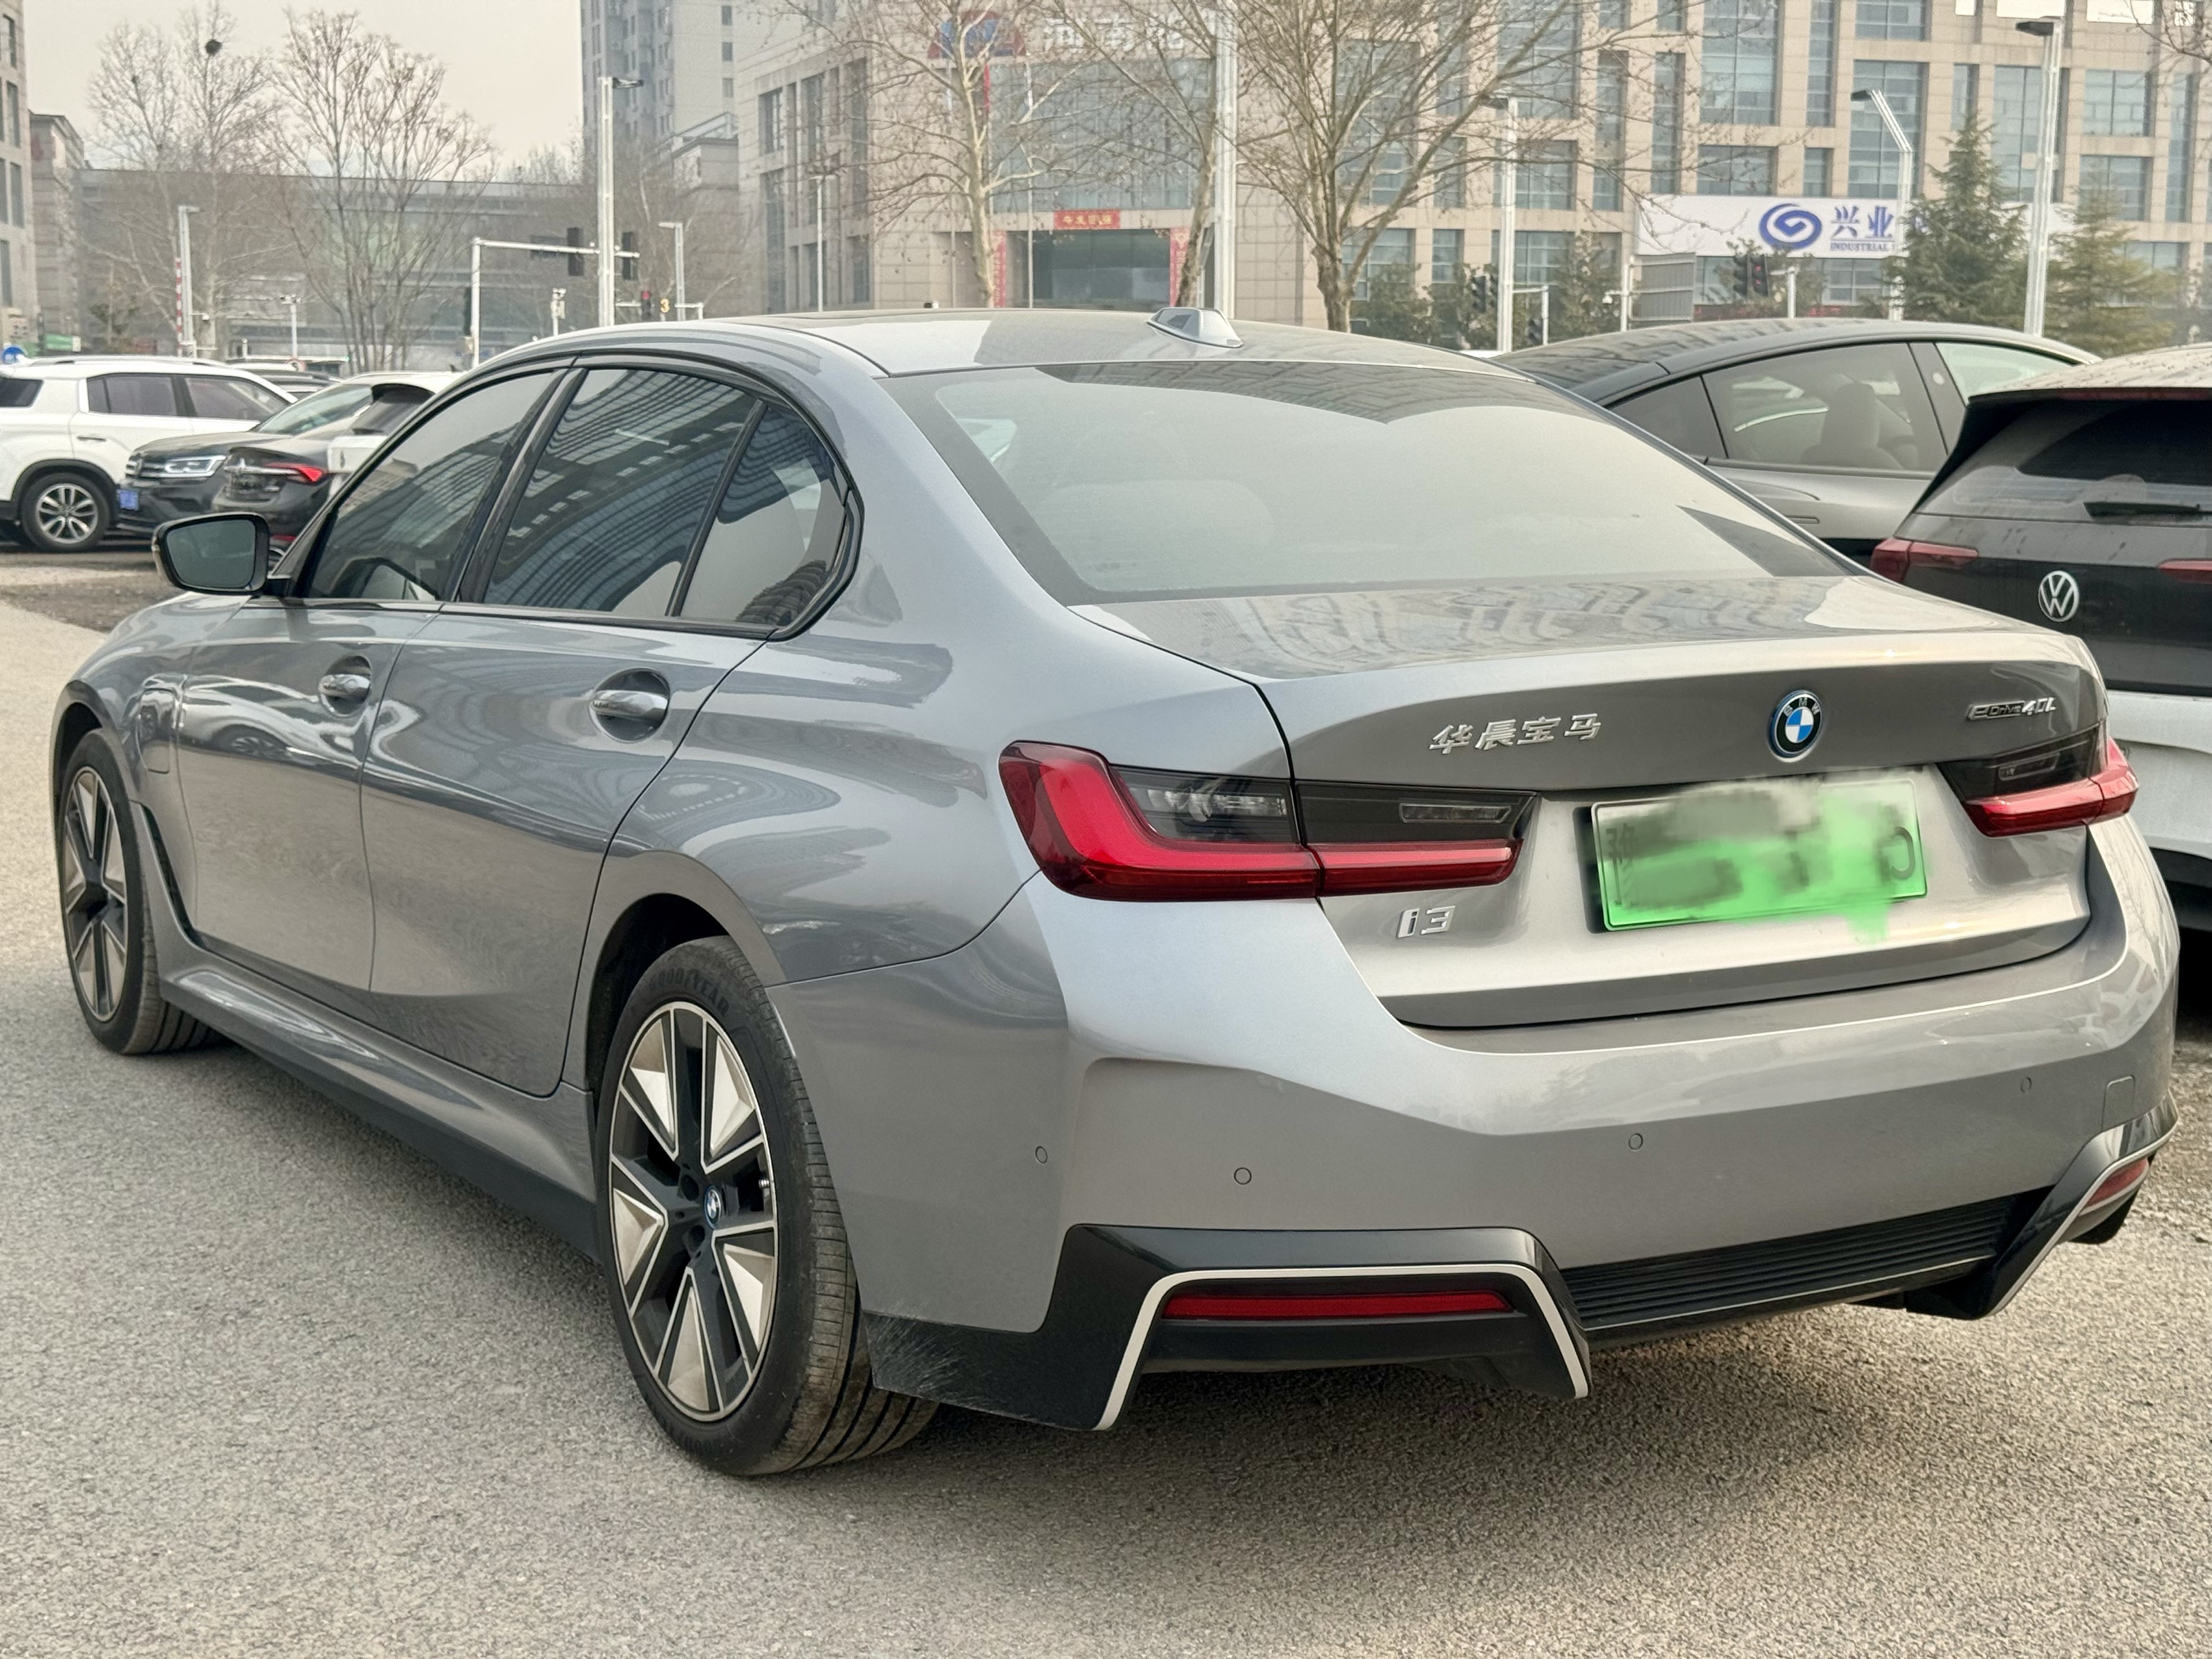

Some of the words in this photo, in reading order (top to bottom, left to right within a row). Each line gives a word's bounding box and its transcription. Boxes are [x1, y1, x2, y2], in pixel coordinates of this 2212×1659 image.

[1830, 241, 1890, 252] INDUSTRIAL
[1428, 712, 1602, 755] 华晨宝马
[1397, 905, 1456, 939] i3
[649, 967, 731, 1016] GOODYEAR
